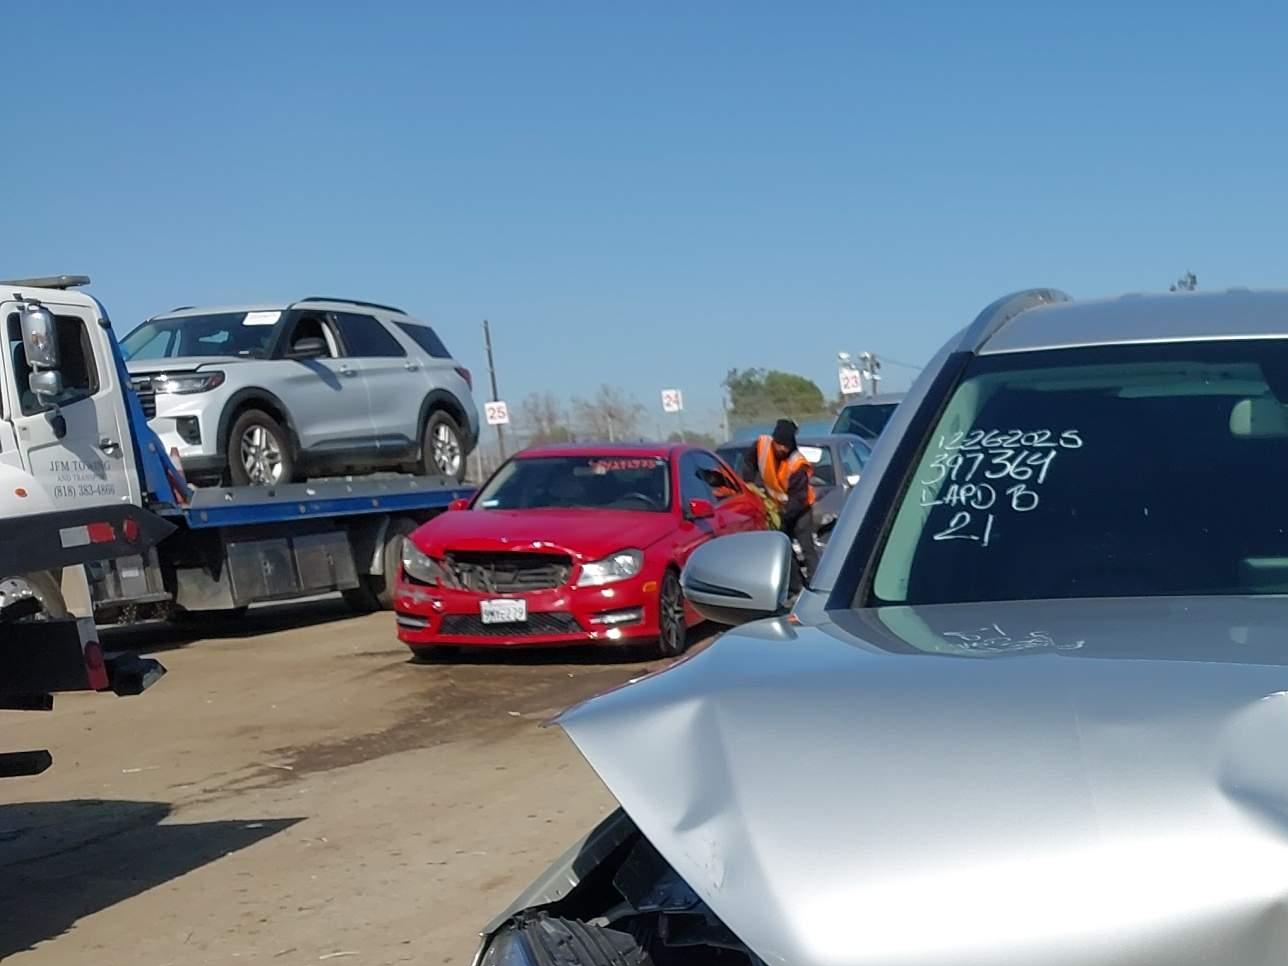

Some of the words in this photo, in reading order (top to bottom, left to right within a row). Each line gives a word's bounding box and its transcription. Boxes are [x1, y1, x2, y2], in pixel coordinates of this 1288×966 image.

[843, 375, 859, 389] 23
[664, 394, 680, 406] 24
[487, 407, 507, 420] 25
[49, 461, 69, 472] JFM
[933, 511, 995, 548] 21
